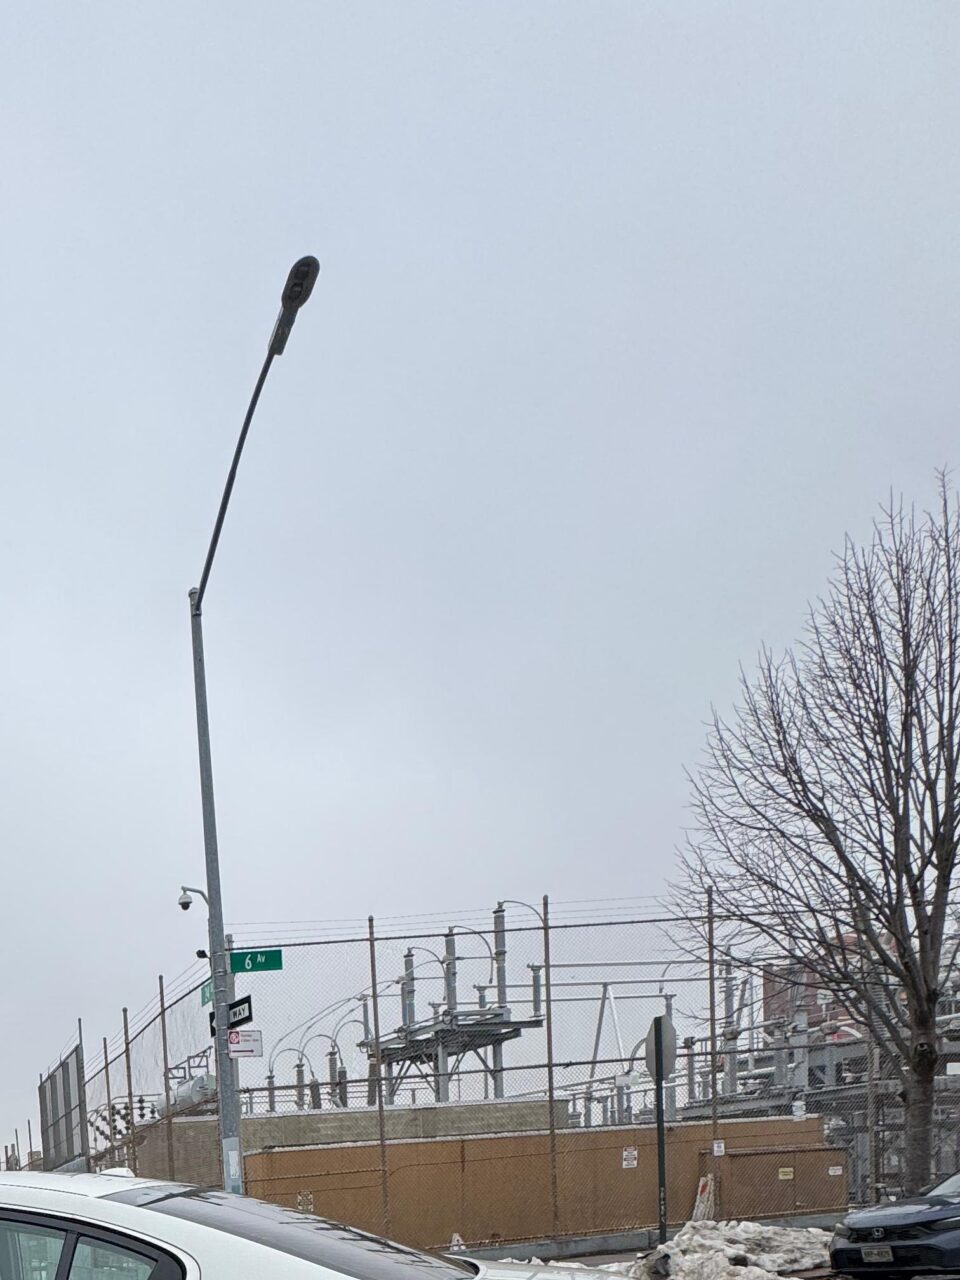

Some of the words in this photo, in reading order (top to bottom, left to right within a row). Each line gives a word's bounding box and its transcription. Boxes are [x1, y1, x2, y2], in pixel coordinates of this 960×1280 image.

[245, 954, 252, 969] 6
[256, 953, 266, 963] Av
[232, 1006, 246, 1020] WAY
